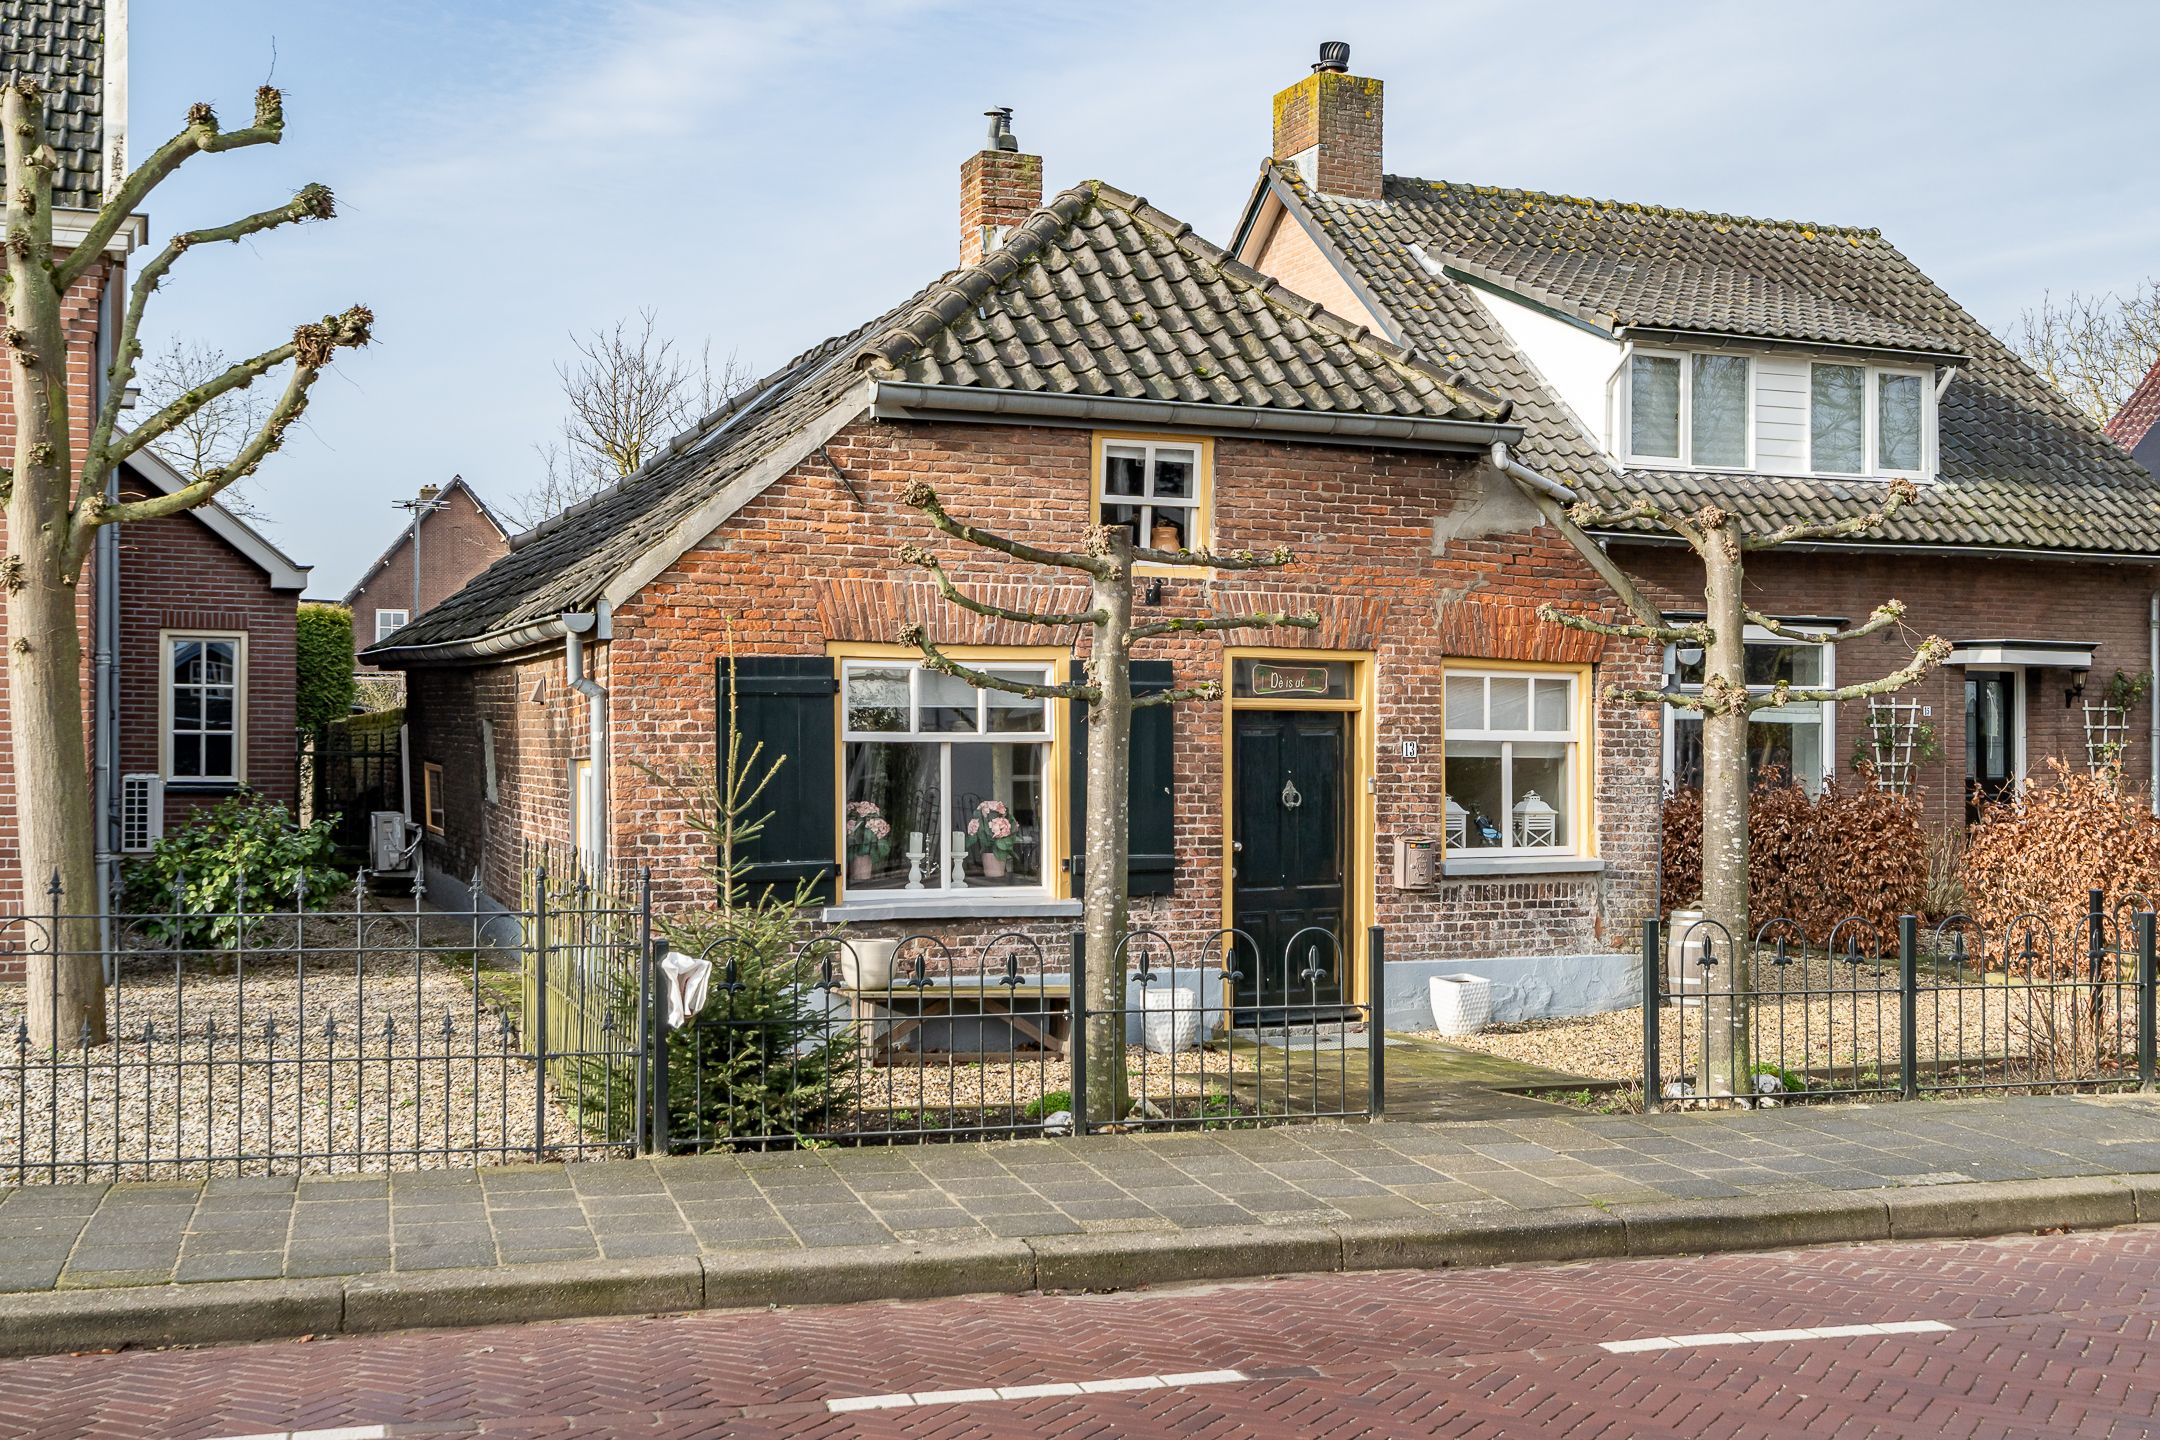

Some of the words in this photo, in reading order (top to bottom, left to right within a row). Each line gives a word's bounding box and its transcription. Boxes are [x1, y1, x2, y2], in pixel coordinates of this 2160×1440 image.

[1270, 672, 1284, 689] Dè
[1285, 676, 1293, 689] is
[1405, 741, 1415, 757] 13
